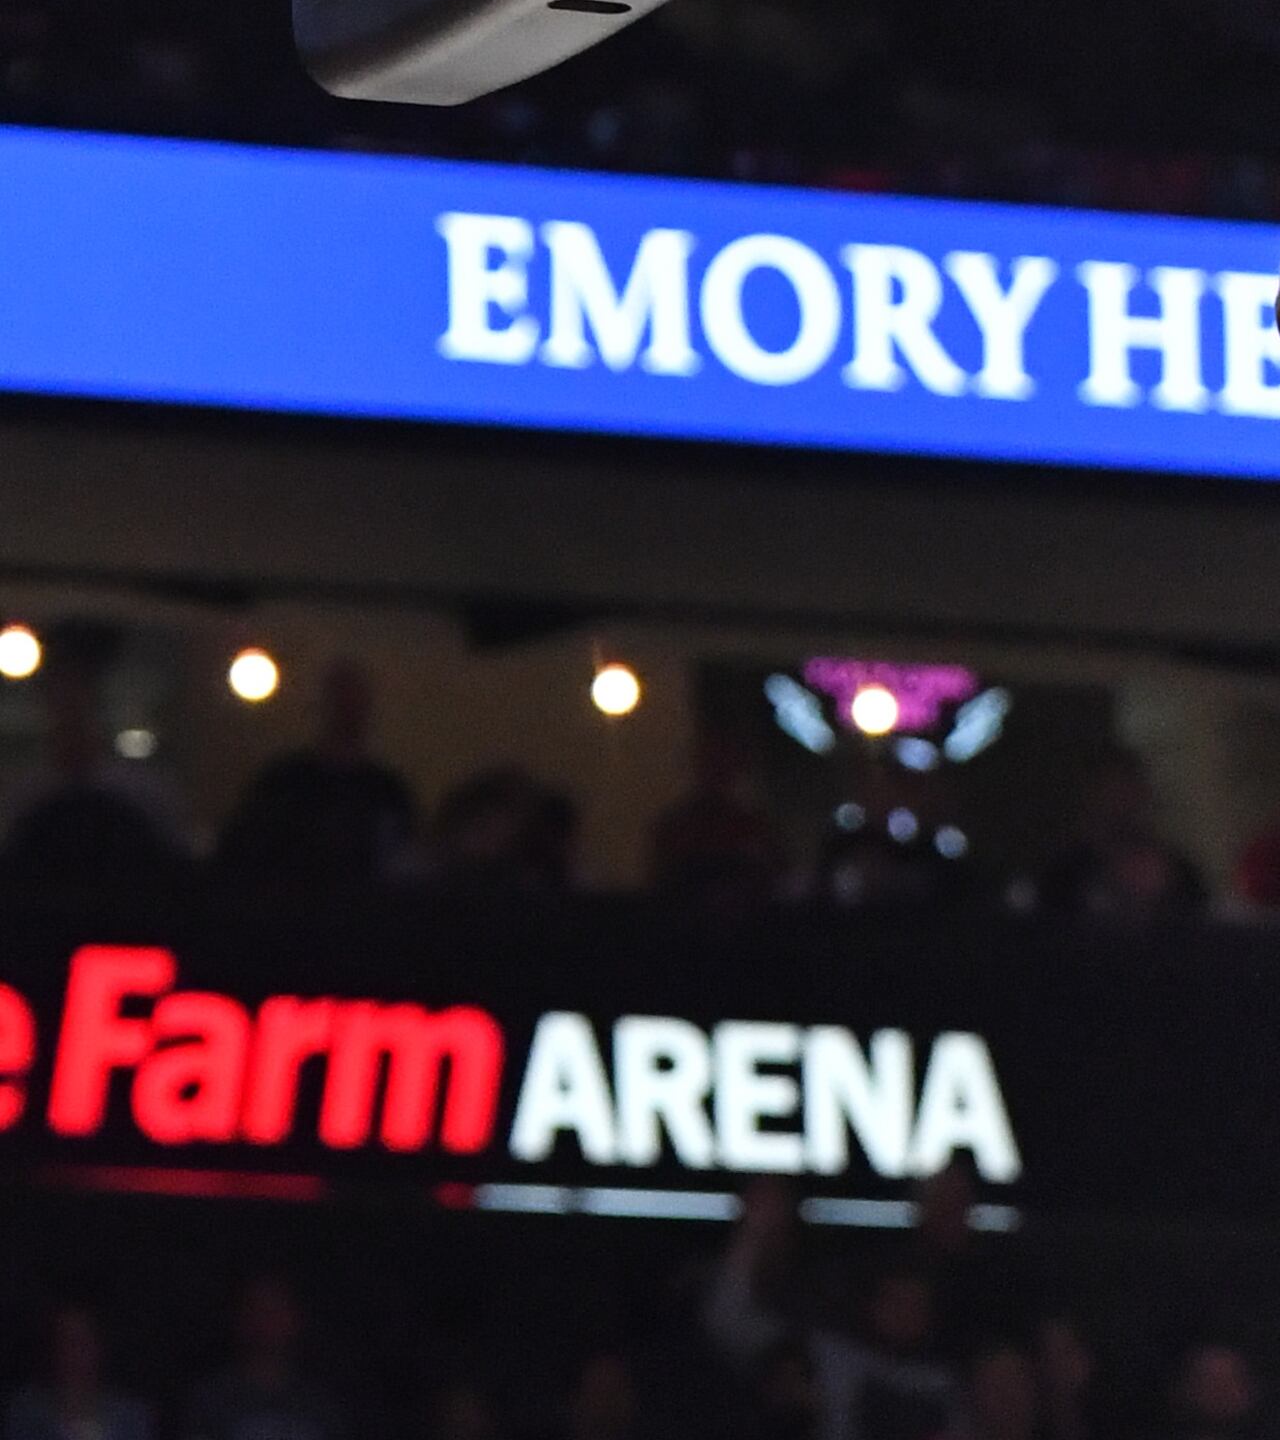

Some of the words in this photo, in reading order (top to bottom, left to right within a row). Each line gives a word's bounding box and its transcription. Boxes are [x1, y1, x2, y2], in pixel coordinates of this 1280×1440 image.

[436, 210, 1056, 402] EMORY
[47, 944, 504, 1153] Farm
[508, 1011, 1021, 1183] ARENA
